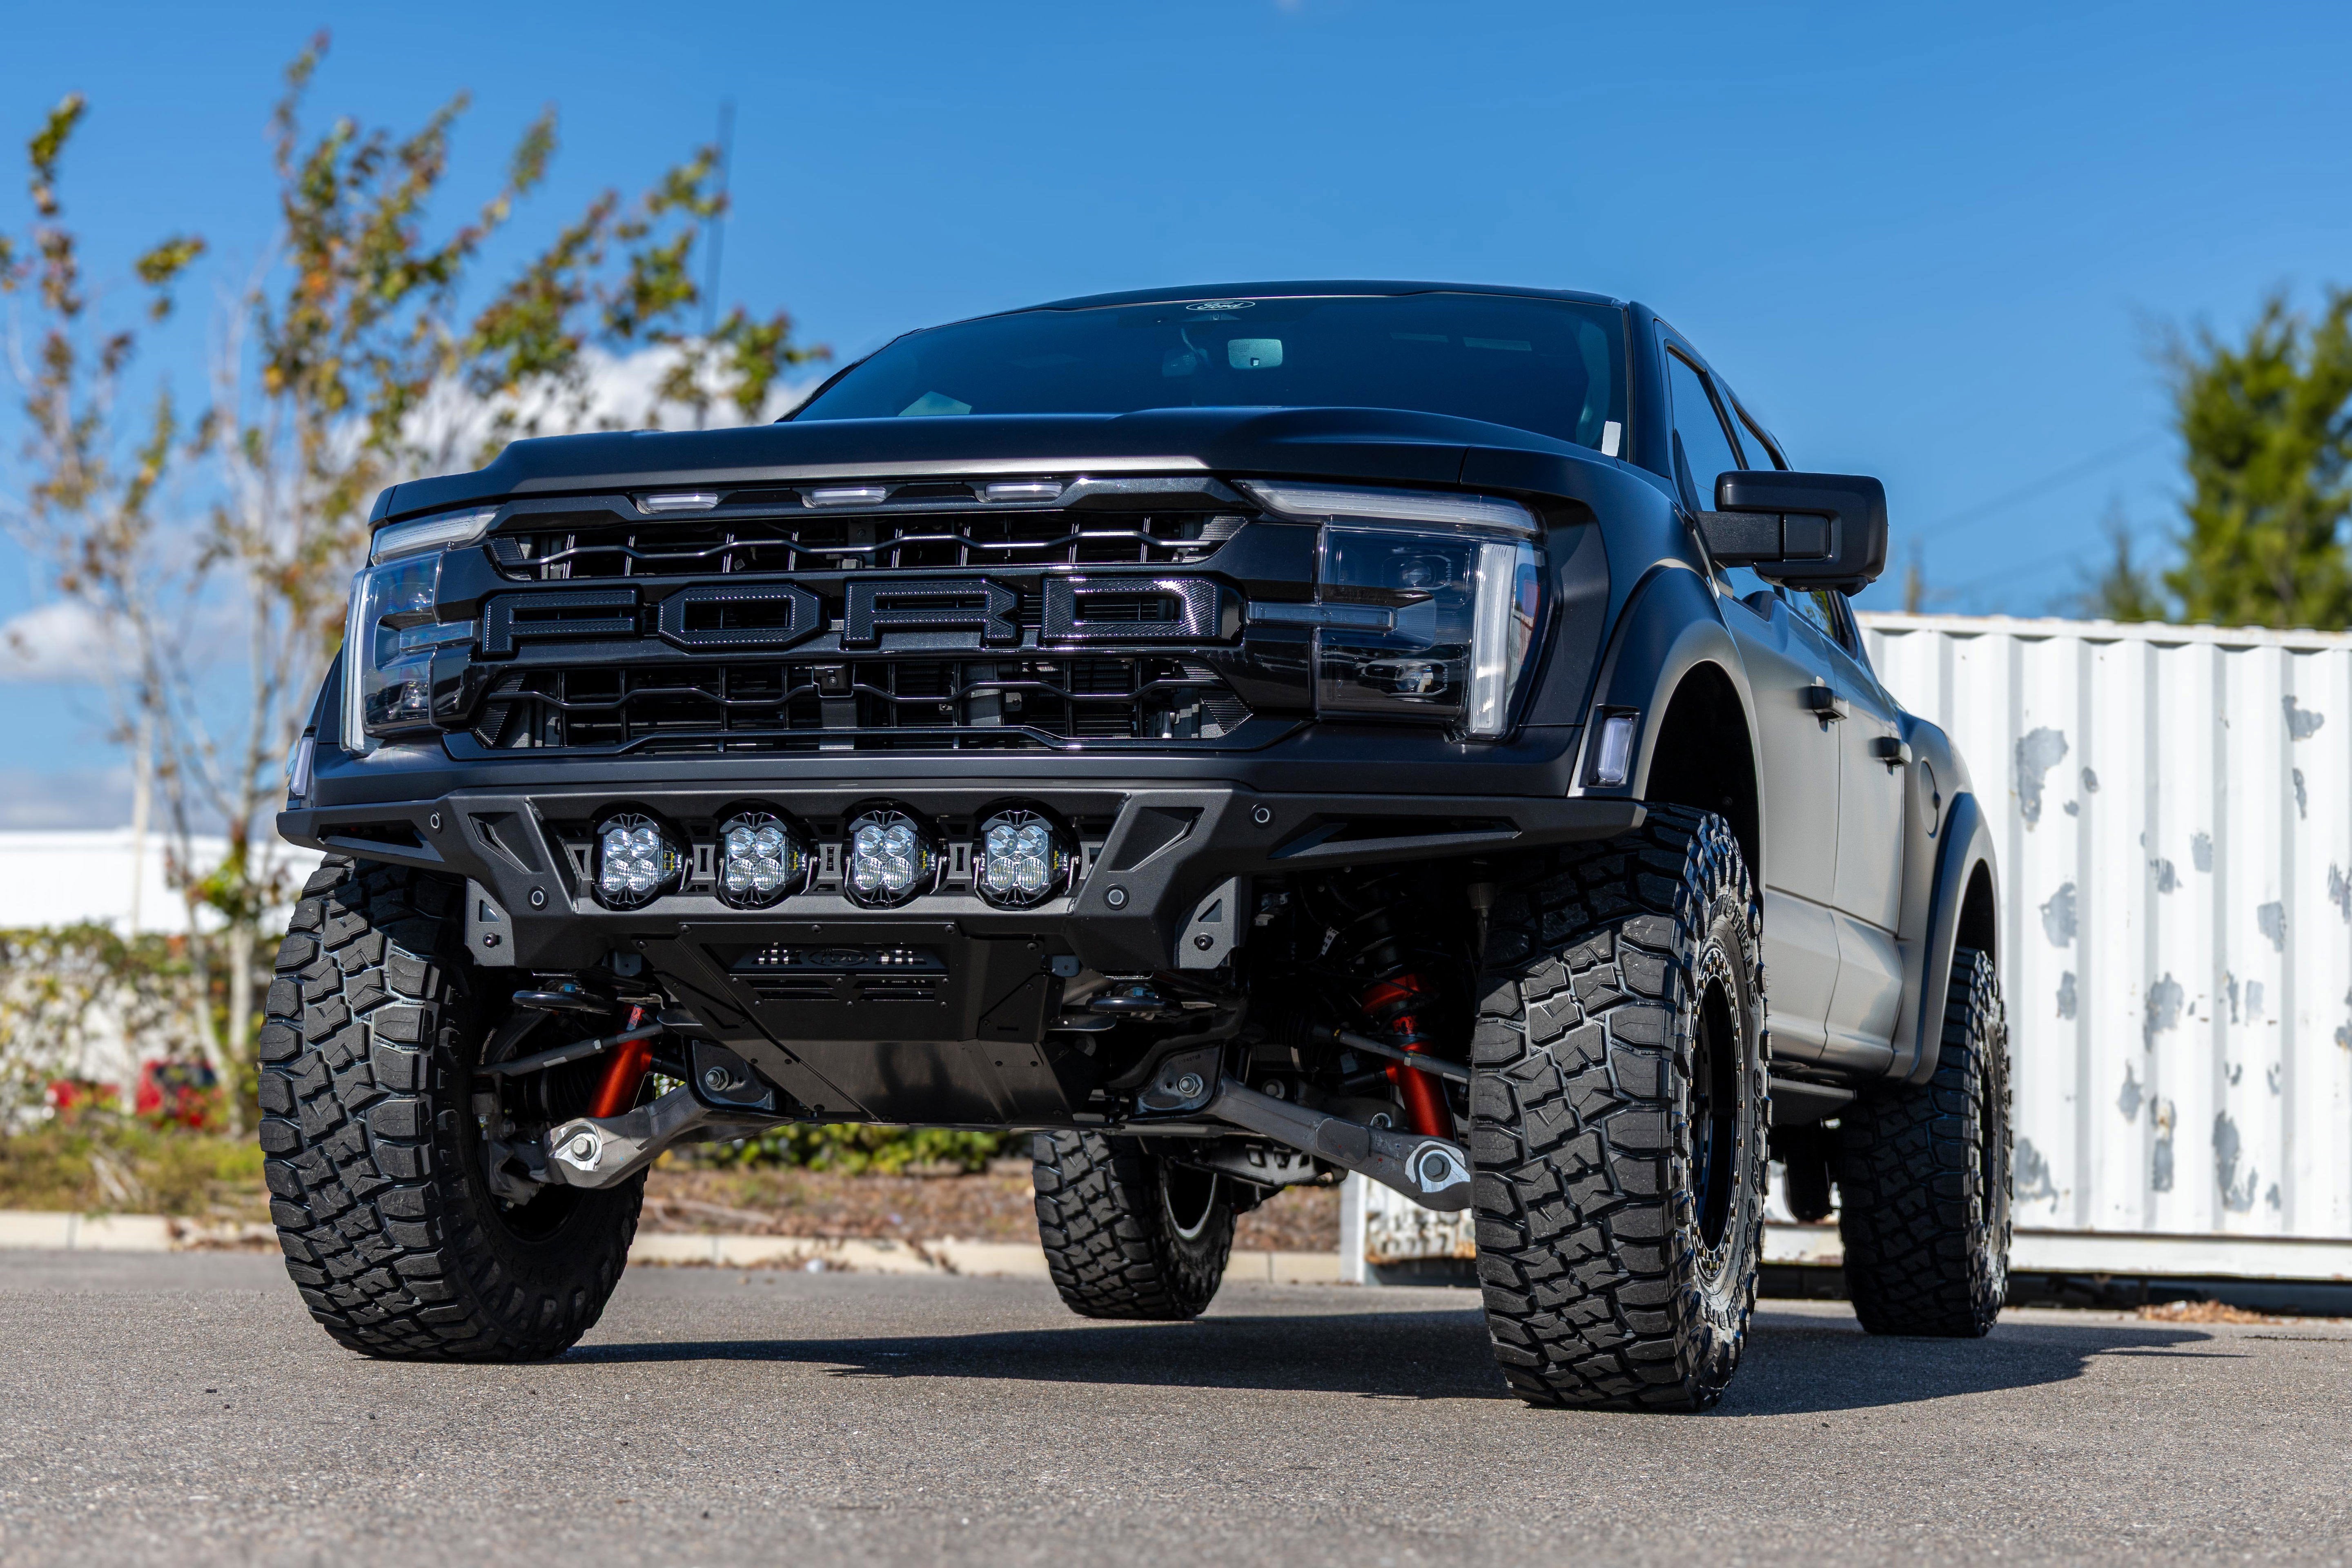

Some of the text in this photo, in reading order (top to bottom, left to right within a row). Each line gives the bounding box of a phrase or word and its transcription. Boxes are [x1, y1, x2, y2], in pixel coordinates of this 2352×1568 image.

[1196, 301, 1245, 310] Ford
[483, 576, 1223, 655] FORD
[1732, 905, 1758, 1007] TIRES
[1751, 1068, 1762, 1194] OPEN
[1726, 1198, 1756, 1329] COUNTRY
